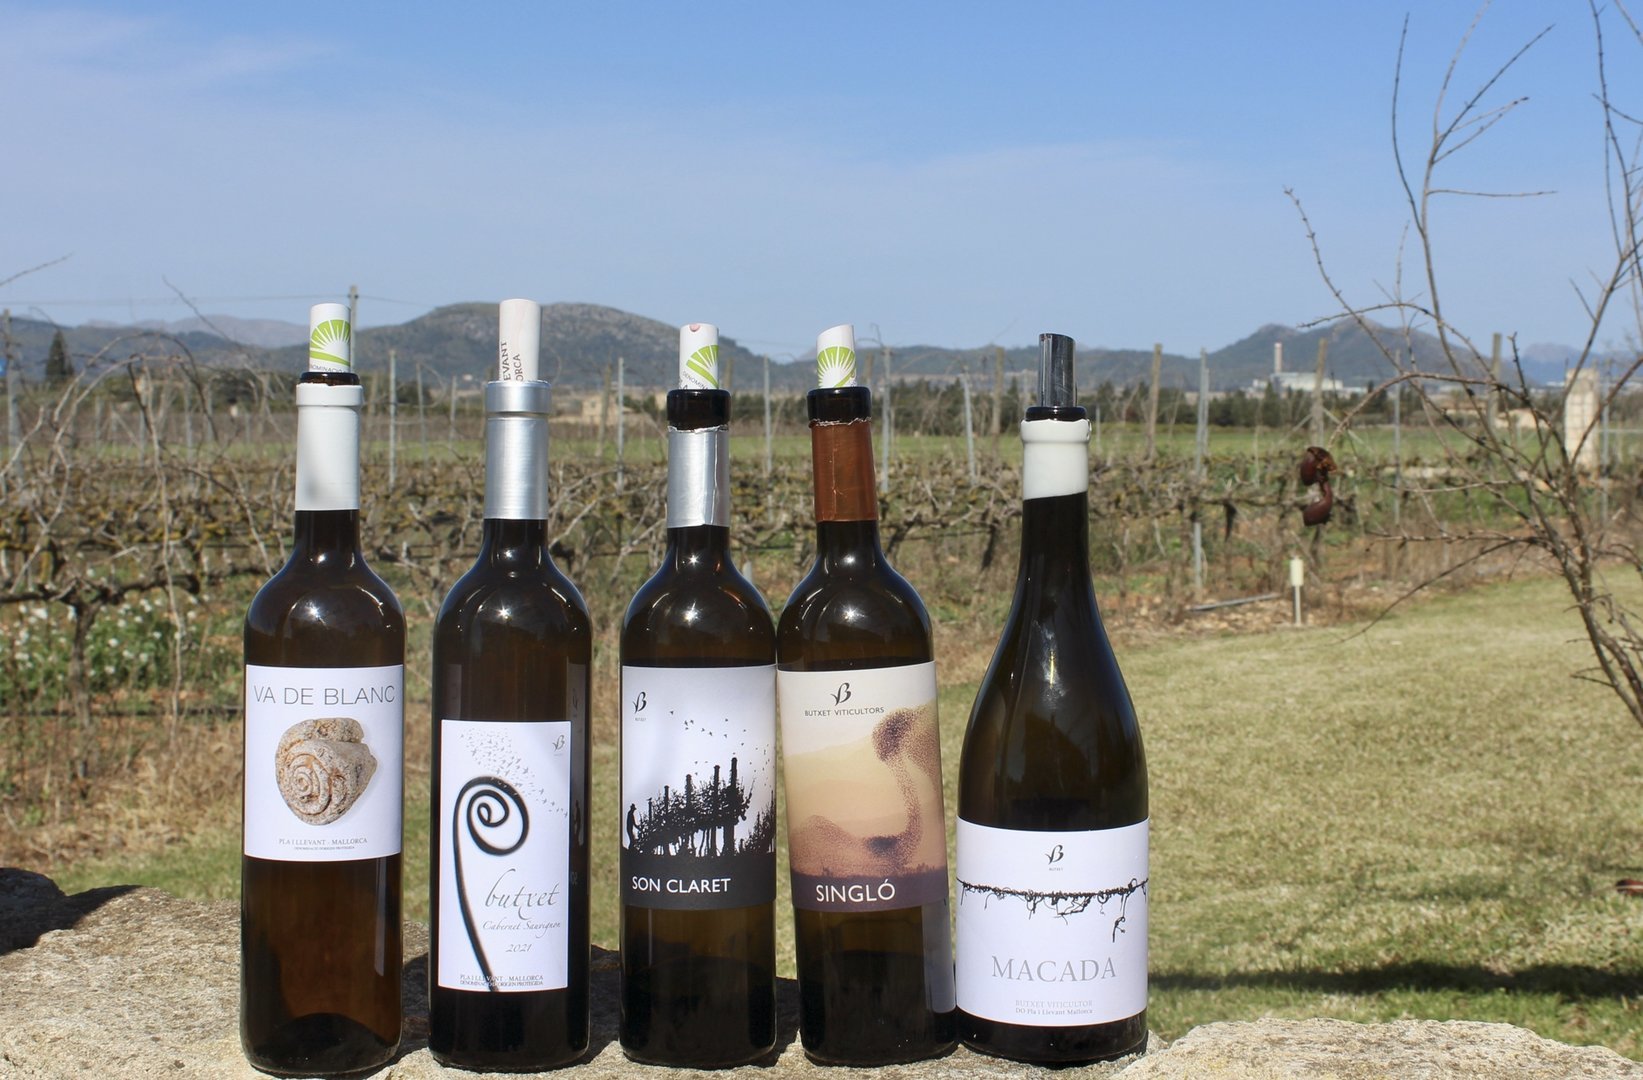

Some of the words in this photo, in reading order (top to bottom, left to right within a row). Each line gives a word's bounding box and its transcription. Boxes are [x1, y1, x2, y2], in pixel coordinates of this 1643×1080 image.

[254, 685, 276, 704] VA
[284, 687, 314, 705] DE
[324, 685, 396, 705] BLANC
[804, 709, 831, 717] BUTXET
[834, 706, 885, 716] VITICULTORS
[331, 837, 368, 846] MALLORCA
[632, 876, 661, 892] SON
[666, 878, 732, 893] CLARET
[815, 878, 896, 903] SINGLÓ
[482, 917, 521, 931] Cabernet
[523, 920, 561, 939] Sauvignon
[505, 943, 532, 953] 2021
[991, 955, 1116, 983] MACADA
